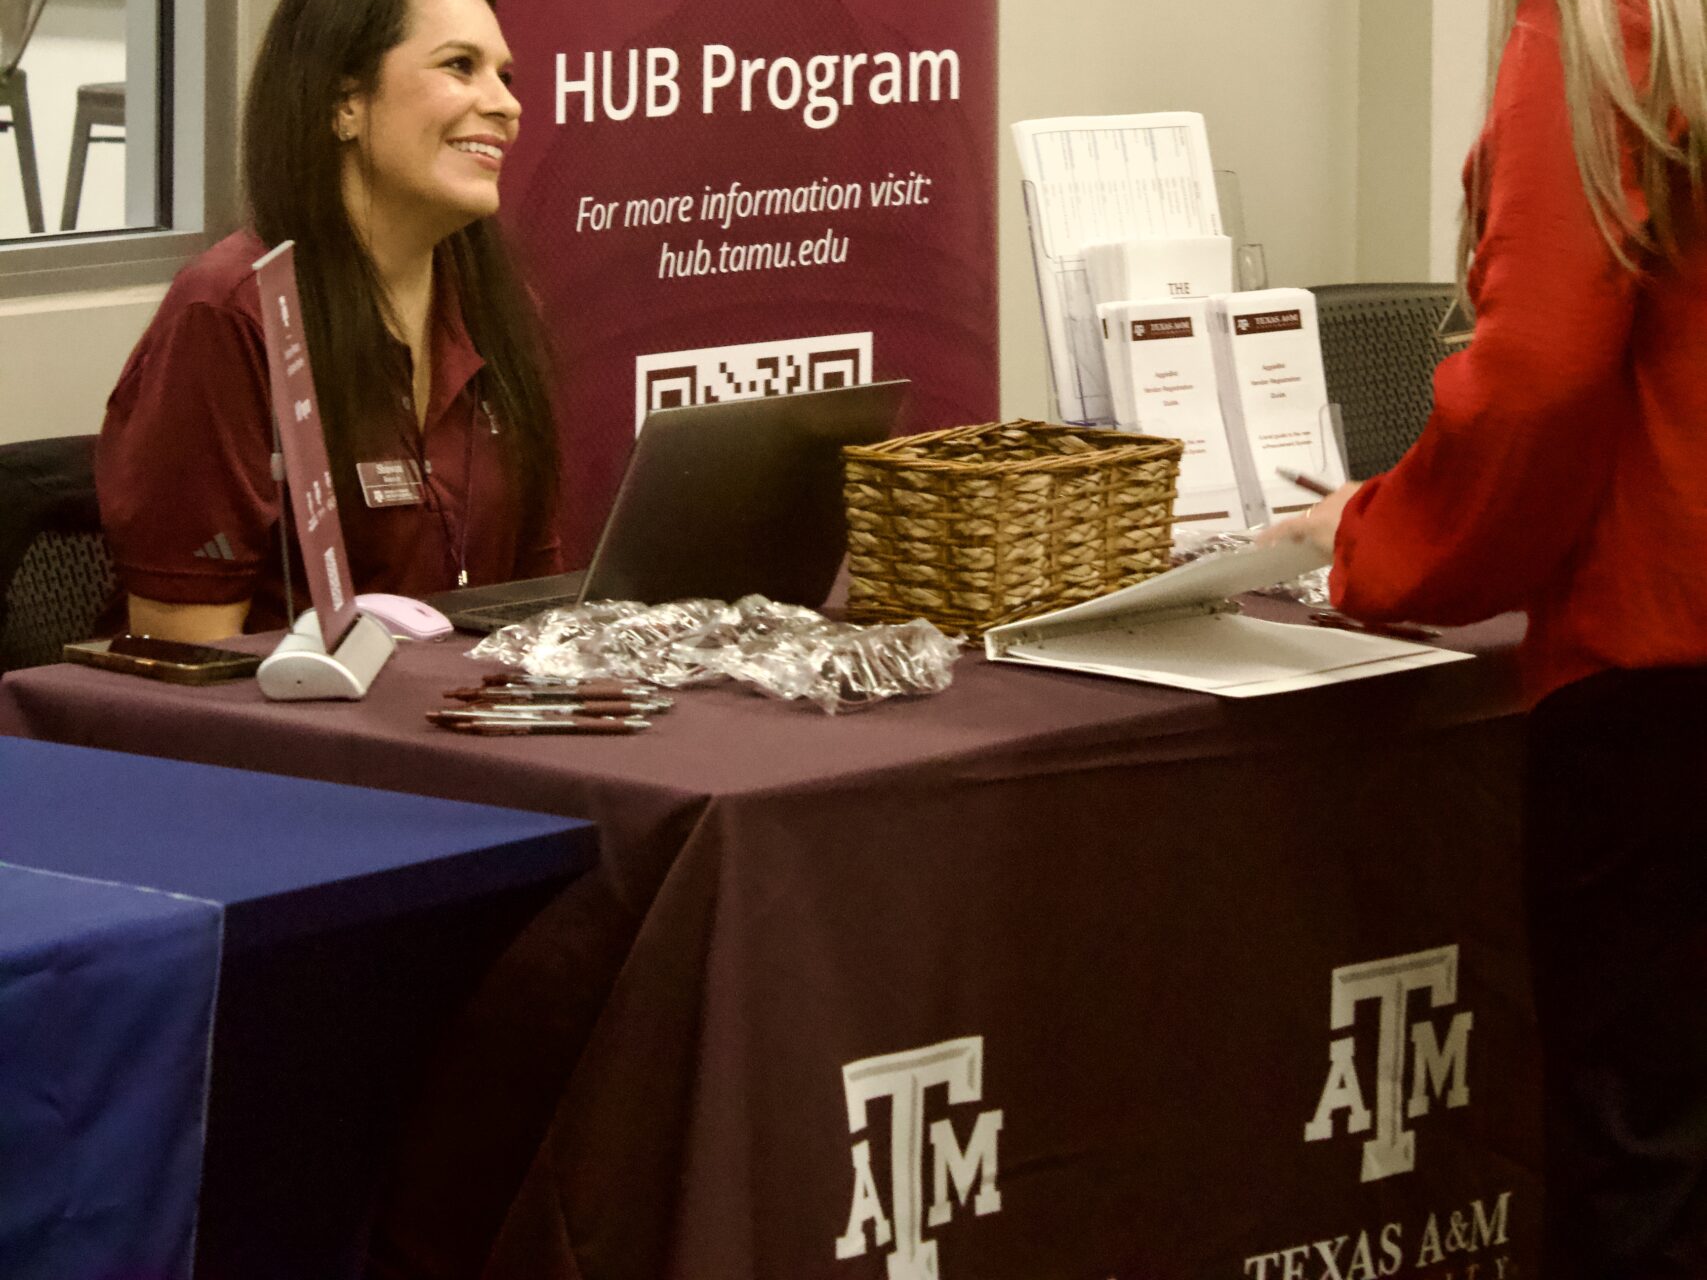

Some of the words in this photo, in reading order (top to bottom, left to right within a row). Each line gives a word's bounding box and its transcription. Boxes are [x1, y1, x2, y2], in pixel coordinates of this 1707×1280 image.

[555, 47, 680, 124] HUB
[702, 44, 960, 129] Program
[576, 196, 619, 232] For
[623, 195, 694, 228] more
[700, 176, 861, 229] information
[870, 171, 932, 207] visit:
[658, 229, 849, 279] hub.tamu.edu
[1167, 282, 1190, 295] THE
[1416, 1191, 1512, 1268] A&M
